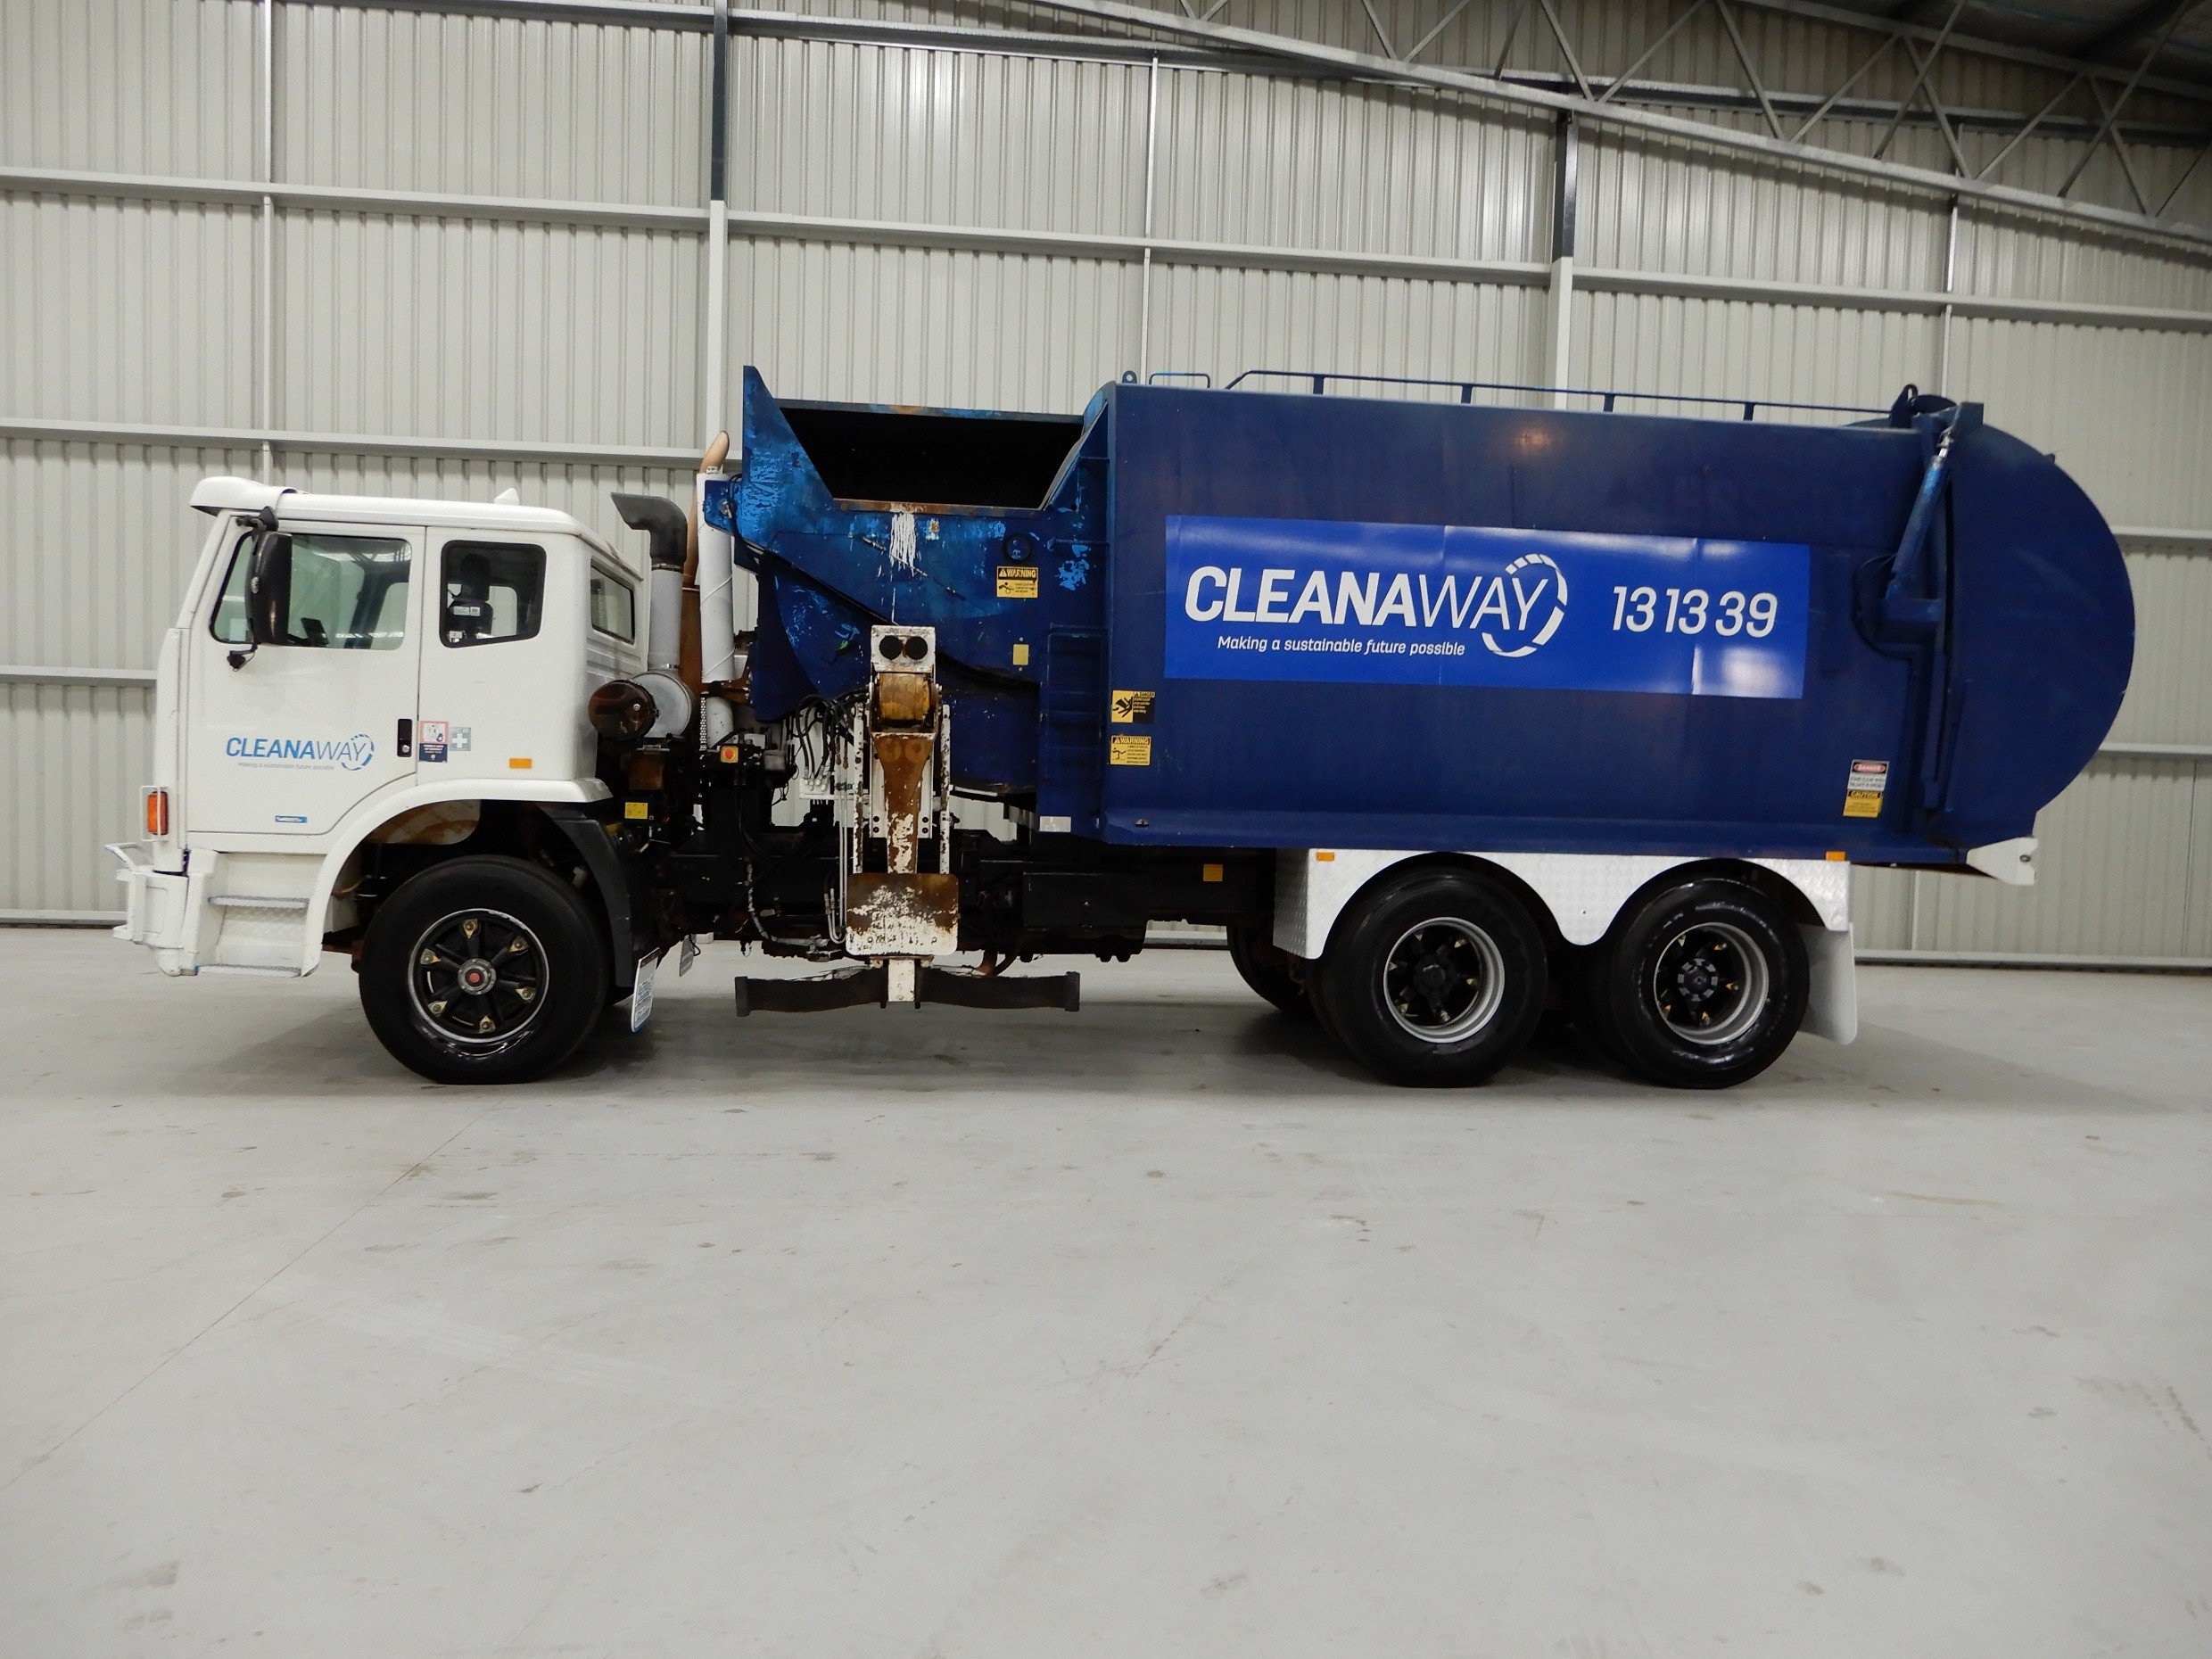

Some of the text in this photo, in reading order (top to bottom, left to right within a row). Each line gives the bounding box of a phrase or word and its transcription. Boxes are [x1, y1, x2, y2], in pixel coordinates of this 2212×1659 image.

[1007, 569, 1036, 578] WARNING
[1184, 565, 1548, 631] CLEANAWAY
[1613, 586, 1778, 638] 13 13 39
[1217, 635, 1465, 656] Making a sustainable future possible
[226, 737, 367, 762] CLEANAWAY
[1120, 737, 1149, 745] WARNING
[1850, 790, 1878, 798] CAUTION
